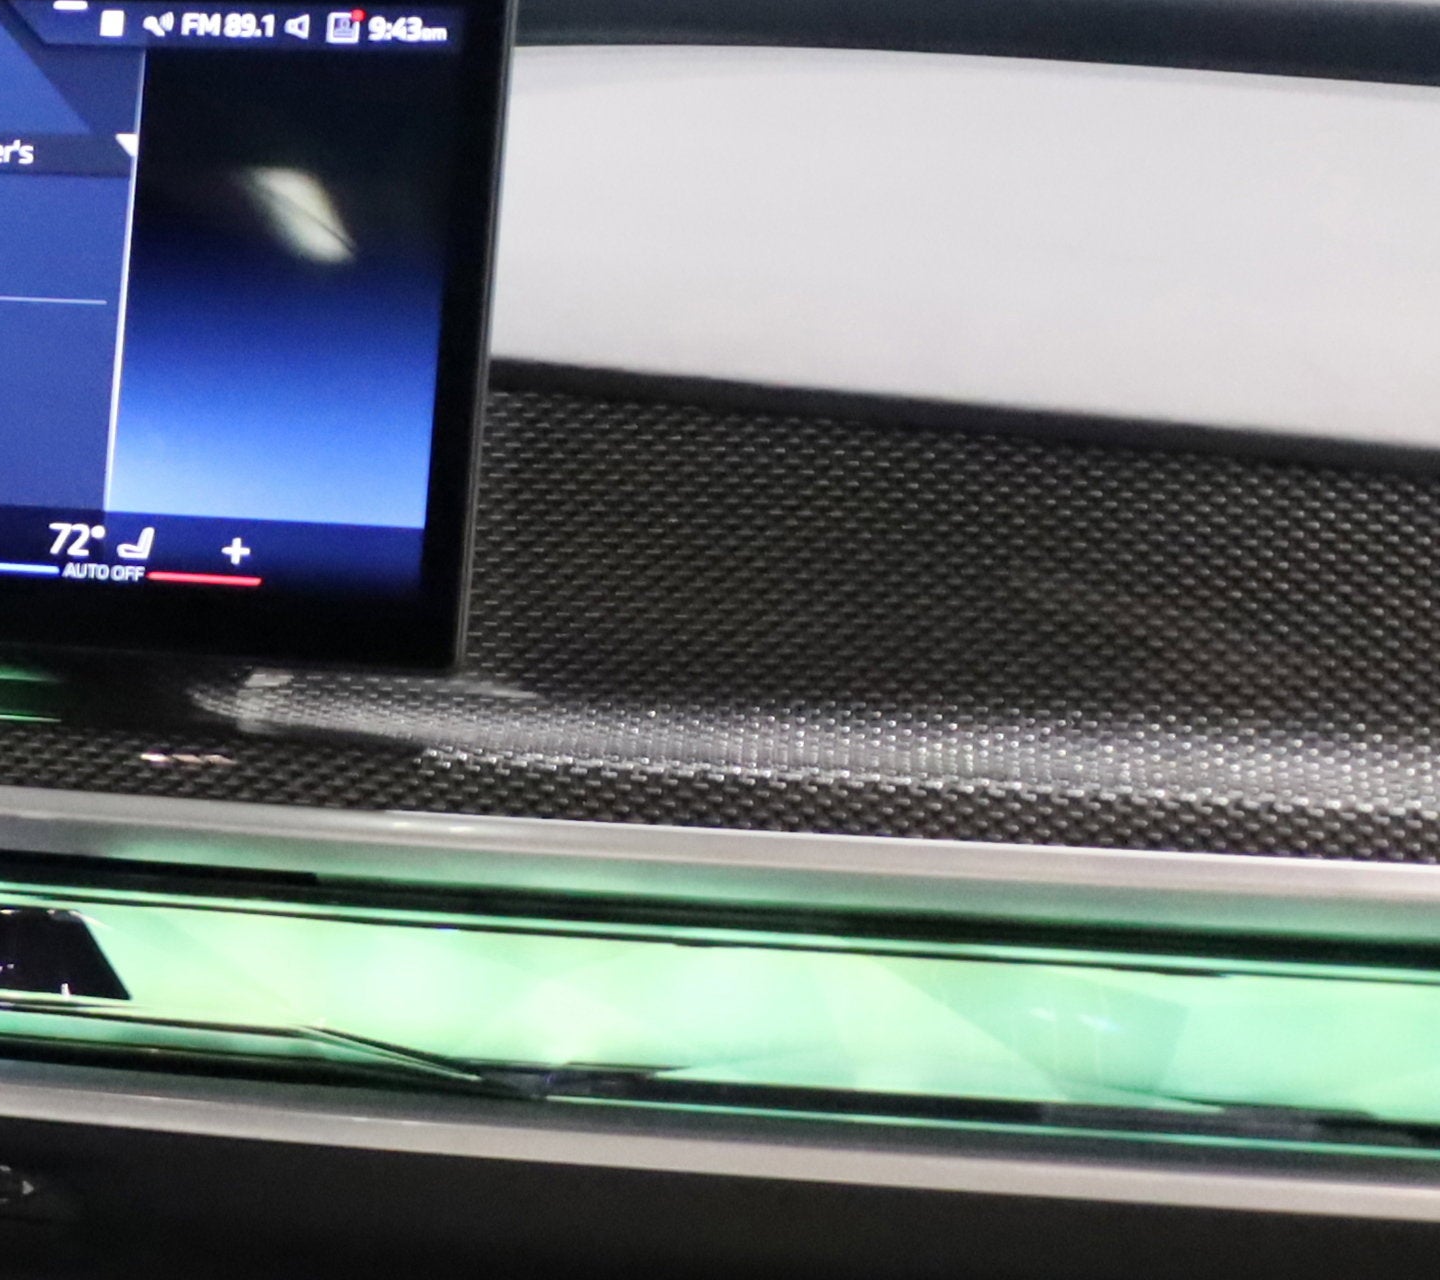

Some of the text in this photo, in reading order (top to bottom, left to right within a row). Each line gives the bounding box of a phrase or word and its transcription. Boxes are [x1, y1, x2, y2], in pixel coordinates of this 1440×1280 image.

[181, 12, 275, 38] FM 89.1
[48, 522, 106, 557] 72°
[61, 561, 146, 582] AUTO OFF
